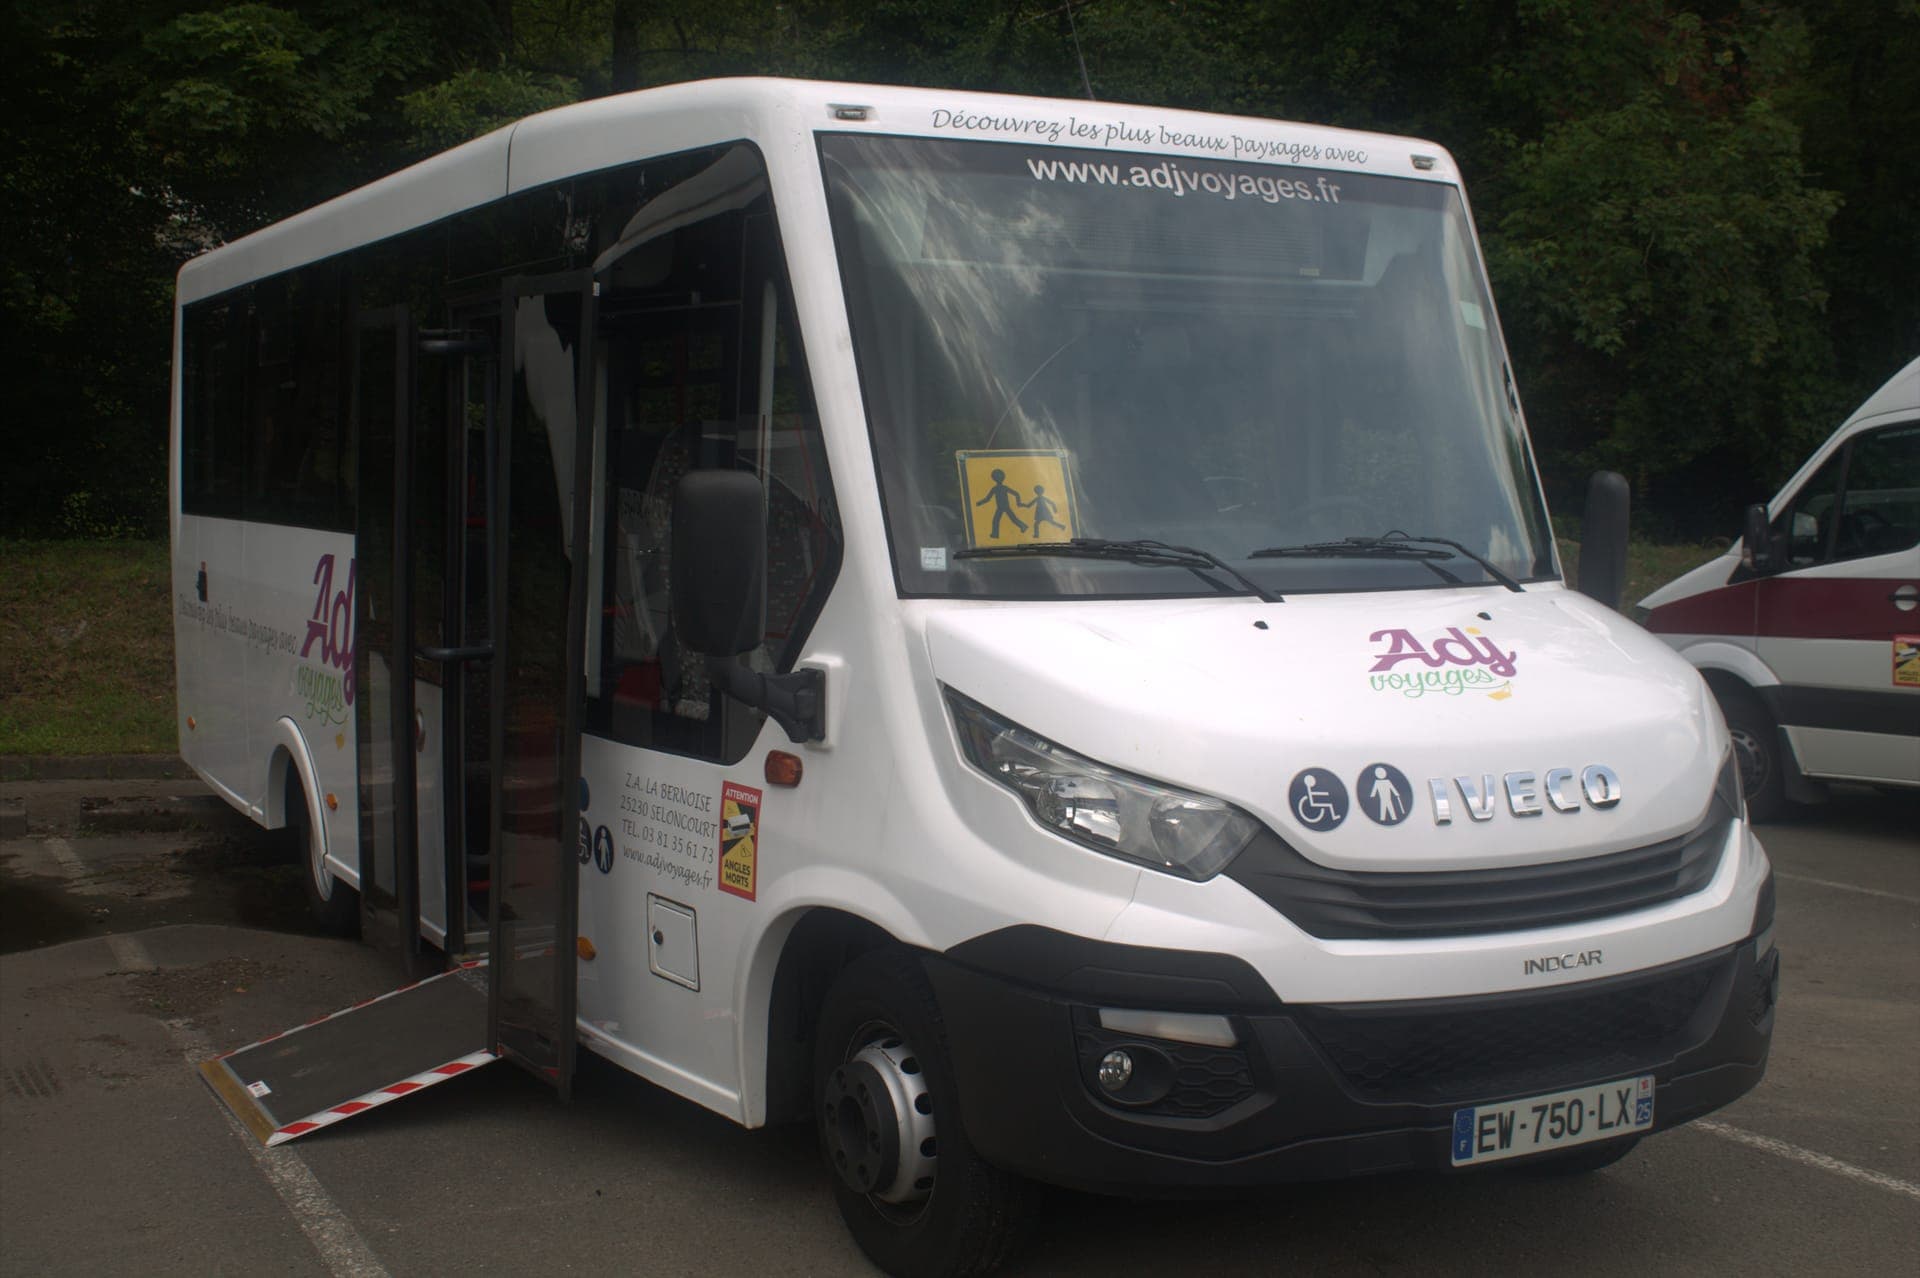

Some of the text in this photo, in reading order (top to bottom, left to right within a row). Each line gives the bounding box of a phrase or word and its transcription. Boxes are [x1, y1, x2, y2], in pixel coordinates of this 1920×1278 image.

[932, 109, 1369, 164] Découvrez les plus beaux paysages avec
[1026, 157, 1341, 203] www.adjvoyages.fr
[1368, 627, 1517, 678] Adj
[1370, 669, 1510, 698] voyages
[625, 772, 711, 813] Z.A. LA BERNOISE
[725, 788, 759, 804] ATTENTION
[1428, 764, 1622, 826] IVECO
[620, 795, 717, 839] 25230 SELONCOURT
[622, 818, 714, 864] TEL. 03 81 35 61 73
[623, 845, 713, 889] www.adjvoyages.fr
[724, 859, 751, 876] ANGLES
[725, 871, 749, 888] MORTS
[1524, 950, 1602, 975] INDCAR
[1478, 1087, 1631, 1153] EW-750-LX
[1637, 1102, 1651, 1121] 25
[1459, 1139, 1467, 1152] F
